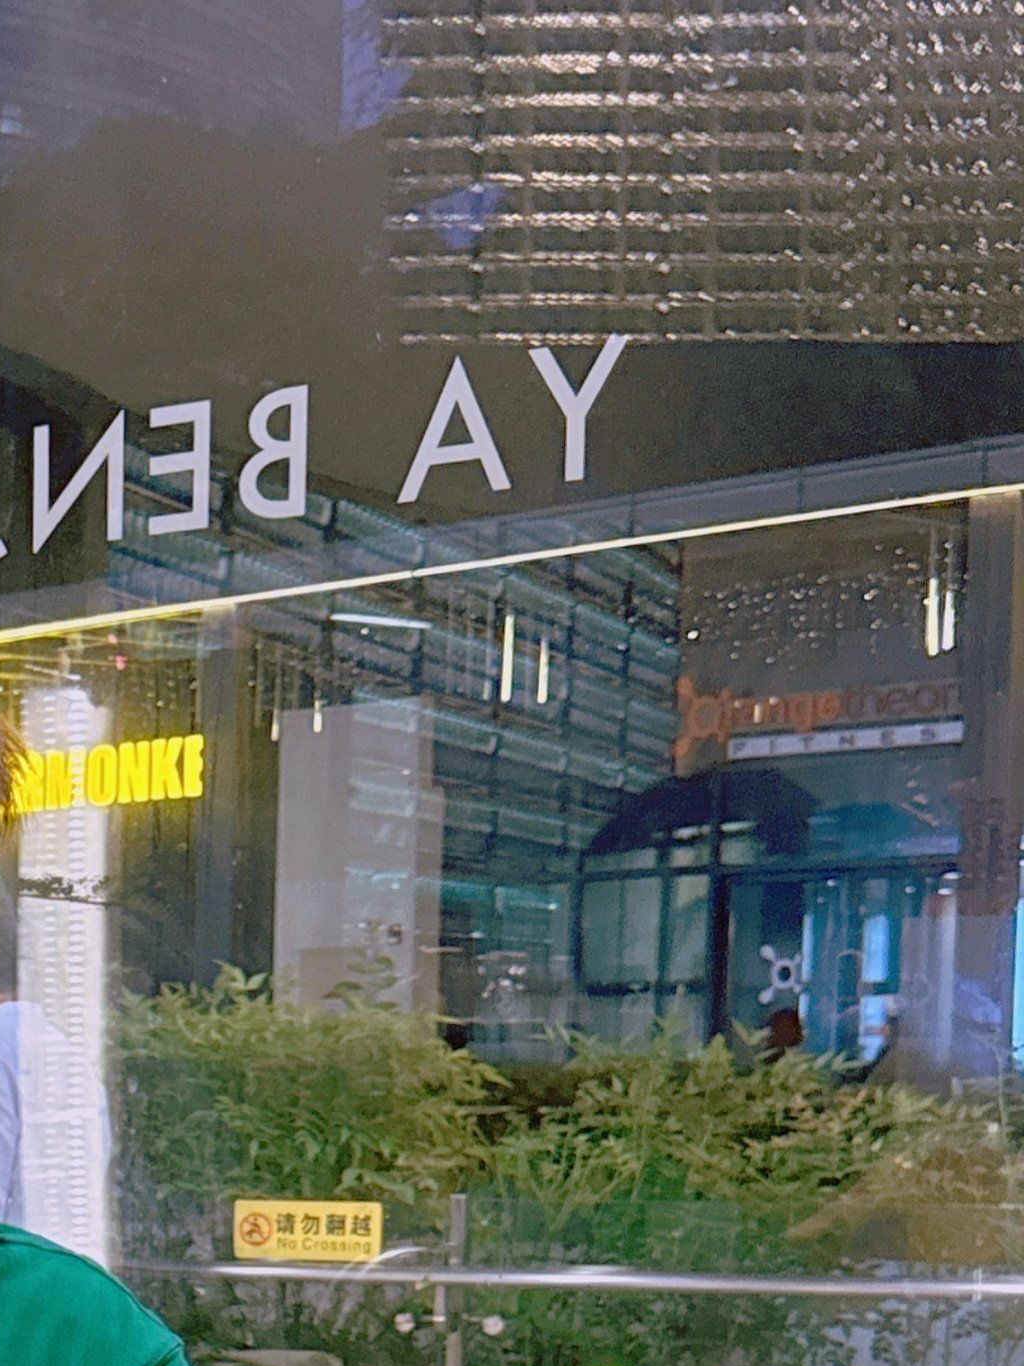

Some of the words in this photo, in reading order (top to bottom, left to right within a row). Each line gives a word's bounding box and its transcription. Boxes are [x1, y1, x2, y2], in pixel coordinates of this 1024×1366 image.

[276, 1212, 372, 1237] 请勿翻越
[277, 1237, 297, 1251] No
[301, 1237, 372, 1255] Crossing
